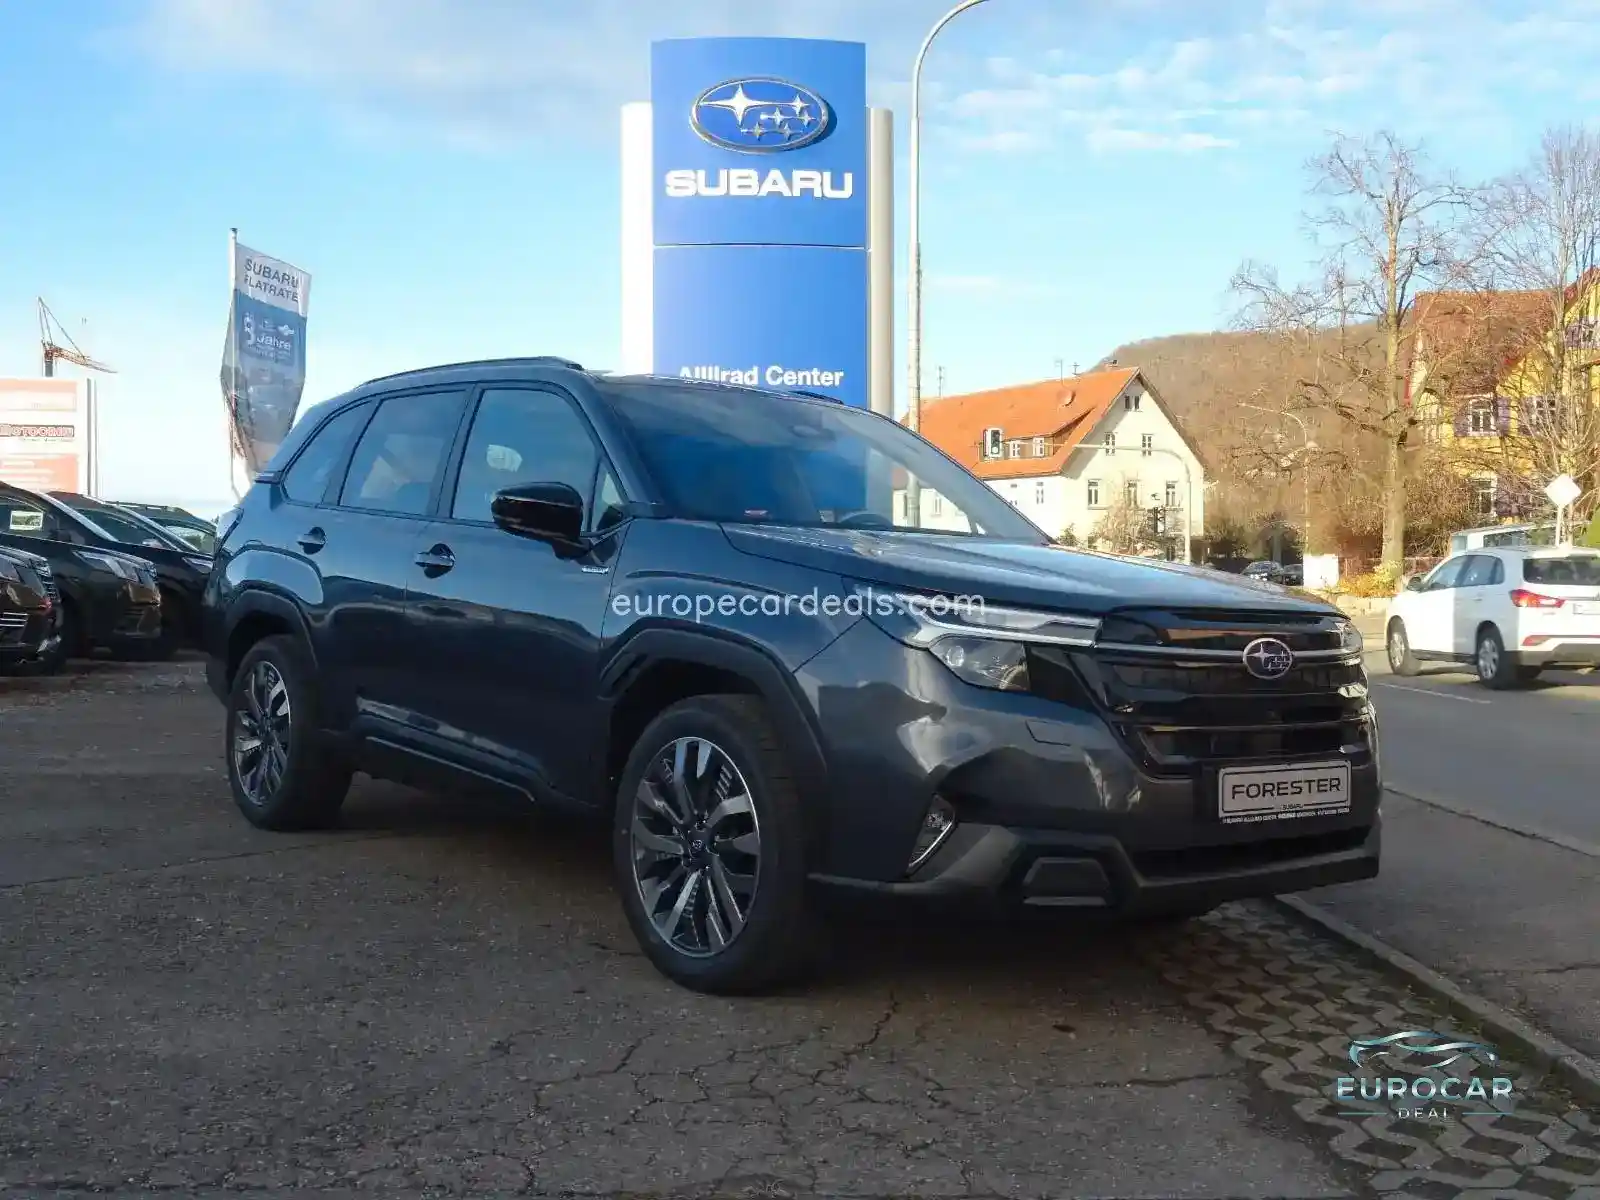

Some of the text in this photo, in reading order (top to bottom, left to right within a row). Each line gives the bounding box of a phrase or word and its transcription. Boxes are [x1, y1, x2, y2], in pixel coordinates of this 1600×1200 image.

[665, 168, 853, 199] SUBARU
[244, 258, 299, 288] SUBARU
[244, 274, 299, 303] FLATRATE
[765, 365, 844, 387] Center
[1231, 777, 1341, 800] FORESTER
